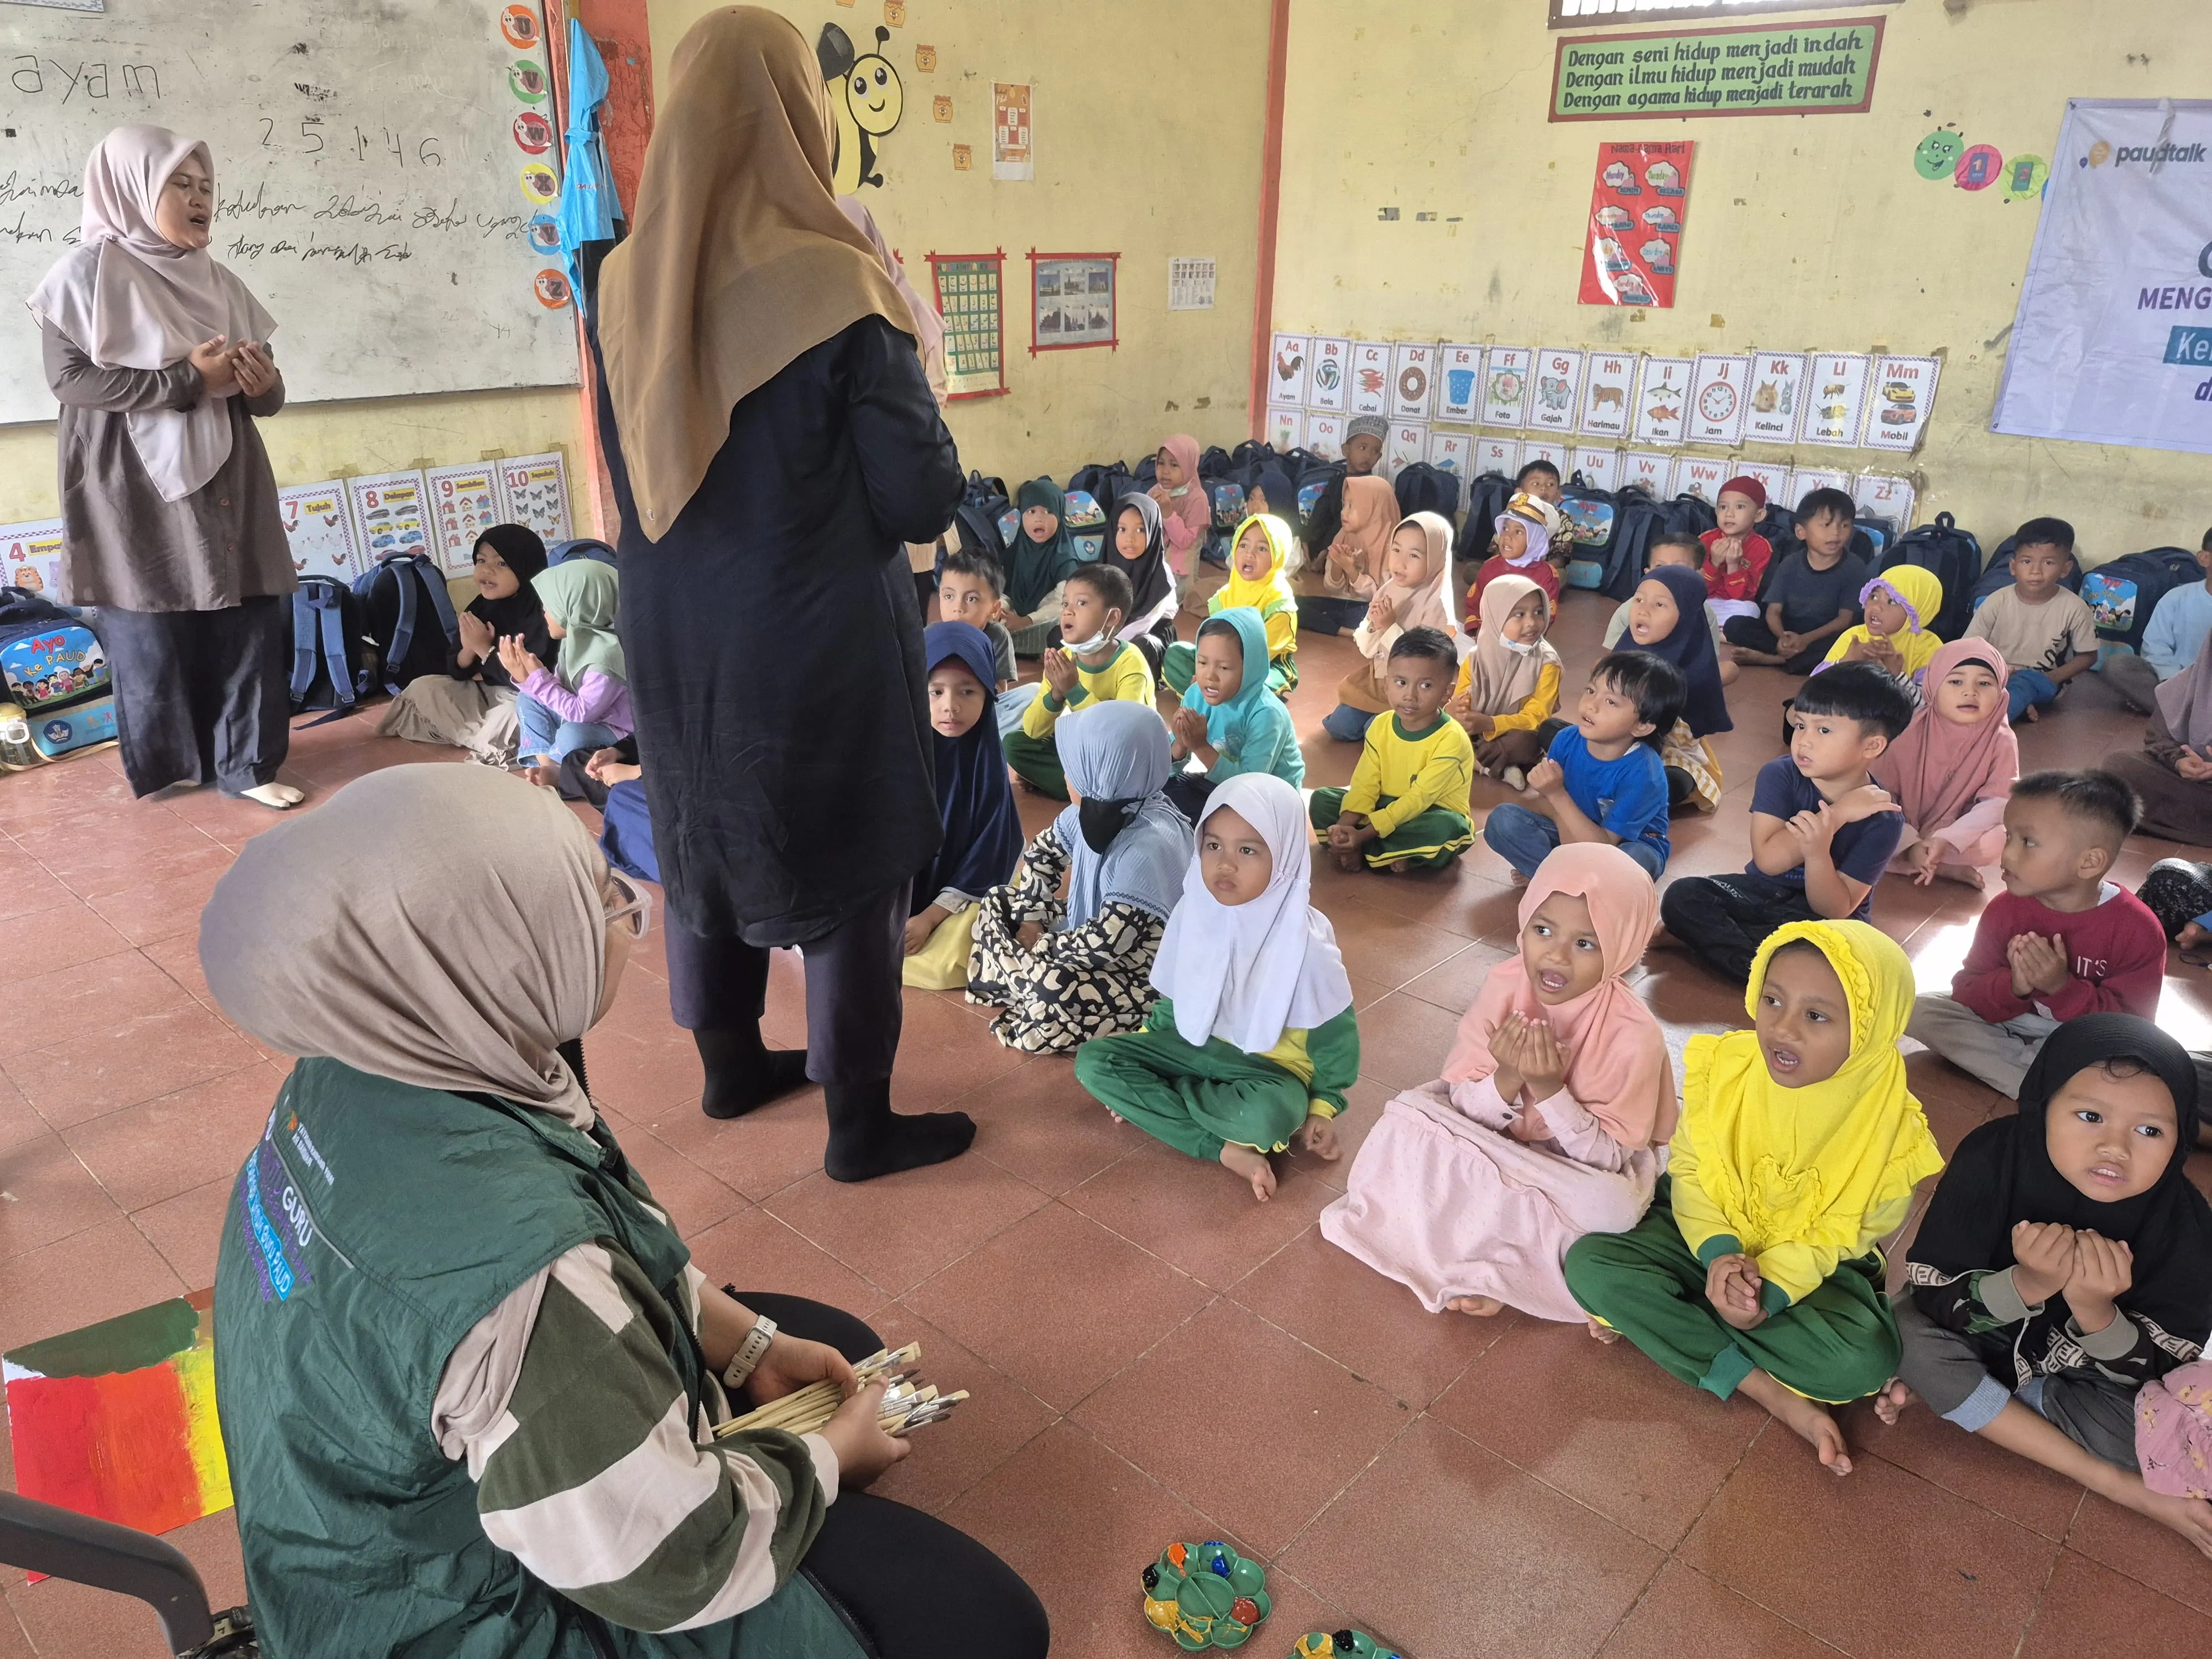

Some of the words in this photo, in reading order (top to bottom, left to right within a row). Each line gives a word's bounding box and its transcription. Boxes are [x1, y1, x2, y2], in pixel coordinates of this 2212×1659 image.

[518, 18, 531, 34] U
[1568, 50, 1625, 70] Dengan
[1632, 46, 1669, 63] seni
[1674, 41, 1720, 64] hidup
[1804, 29, 1863, 53] indah
[525, 71, 539, 88] V
[1566, 72, 1624, 91] Dengan
[1629, 64, 1667, 85] ilmu
[1671, 62, 1717, 85] hidup
[1798, 54, 1856, 76] mudah
[12, 55, 160, 105] ayam
[1563, 92, 1621, 112] Dengan
[1627, 91, 1680, 109] agama
[1684, 85, 1722, 107] hidup
[1726, 81, 1783, 106] menjadi
[1788, 77, 1853, 99] terarah
[528, 127, 545, 140] W
[2114, 143, 2207, 167] paudtalk
[1973, 159, 1982, 171] 1
[535, 175, 551, 192] X
[541, 226, 555, 242] Y
[550, 280, 562, 298] Z
[2137, 286, 2212, 310] MENG
[1286, 341, 1299, 352] Aa
[1325, 343, 1338, 356] Bb
[2176, 332, 2212, 361] Ke
[1366, 349, 1378, 361] Cc
[1410, 350, 1425, 362] Dd
[1455, 351, 1469, 363] Ee
[1504, 353, 1516, 366] Ff
[1552, 357, 1569, 375] Gg
[1604, 361, 1621, 374] Hh
[1663, 366, 1672, 379] Ii
[1718, 363, 1729, 380] Jj
[1770, 360, 1789, 375] Kk
[1833, 362, 1846, 376] Ll
[1886, 363, 1919, 379] Mm
[2194, 376, 2212, 401] d
[1359, 404, 1376, 412] Cabai
[1401, 405, 1420, 414] Donat
[1495, 410, 1510, 419] Foto
[1280, 415, 1292, 426] Nn
[1541, 414, 1562, 423] Gajah
[1588, 420, 1620, 430] Harimau
[1319, 422, 1333, 434] Oo
[1652, 427, 1669, 436] Ikan
[1755, 422, 1783, 432] Kelinci
[1817, 427, 1843, 437] Lebah
[1401, 429, 1416, 444] Qq
[1881, 431, 1908, 441] Mobil
[1444, 440, 1457, 452] Rr
[1491, 446, 1503, 458] Ss
[1587, 455, 1604, 468] Uu
[1639, 460, 1655, 473] Vv
[508, 471, 529, 488] 10
[1691, 466, 1718, 480] Ww
[441, 481, 454, 498] 9
[1875, 486, 1892, 500] Zz
[366, 491, 379, 508] 8
[384, 491, 415, 500] Delapan
[285, 501, 298, 519] 7
[306, 502, 331, 513] Tujuh
[9, 542, 26, 562] 4
[29, 542, 62, 553] Empa
[45, 650, 86, 665] PAUD
[2077, 955, 2107, 977] IT'S
[283, 1186, 313, 1246] GURU
